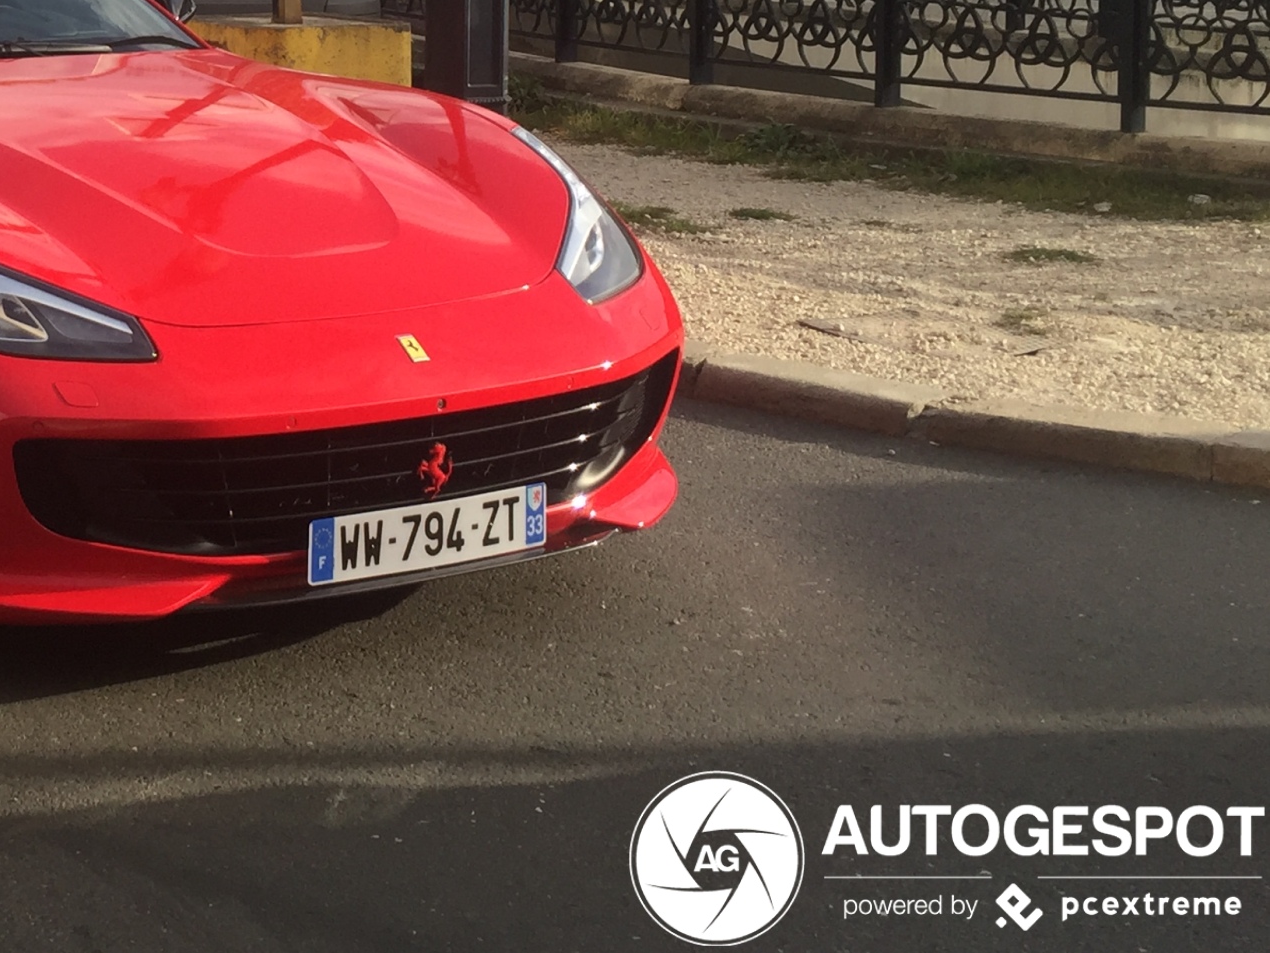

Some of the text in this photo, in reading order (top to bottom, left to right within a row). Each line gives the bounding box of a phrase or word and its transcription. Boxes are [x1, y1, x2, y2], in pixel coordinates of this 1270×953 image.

[340, 495, 521, 571] WW-794-ZT
[526, 513, 543, 537] 33
[318, 555, 326, 570] F
